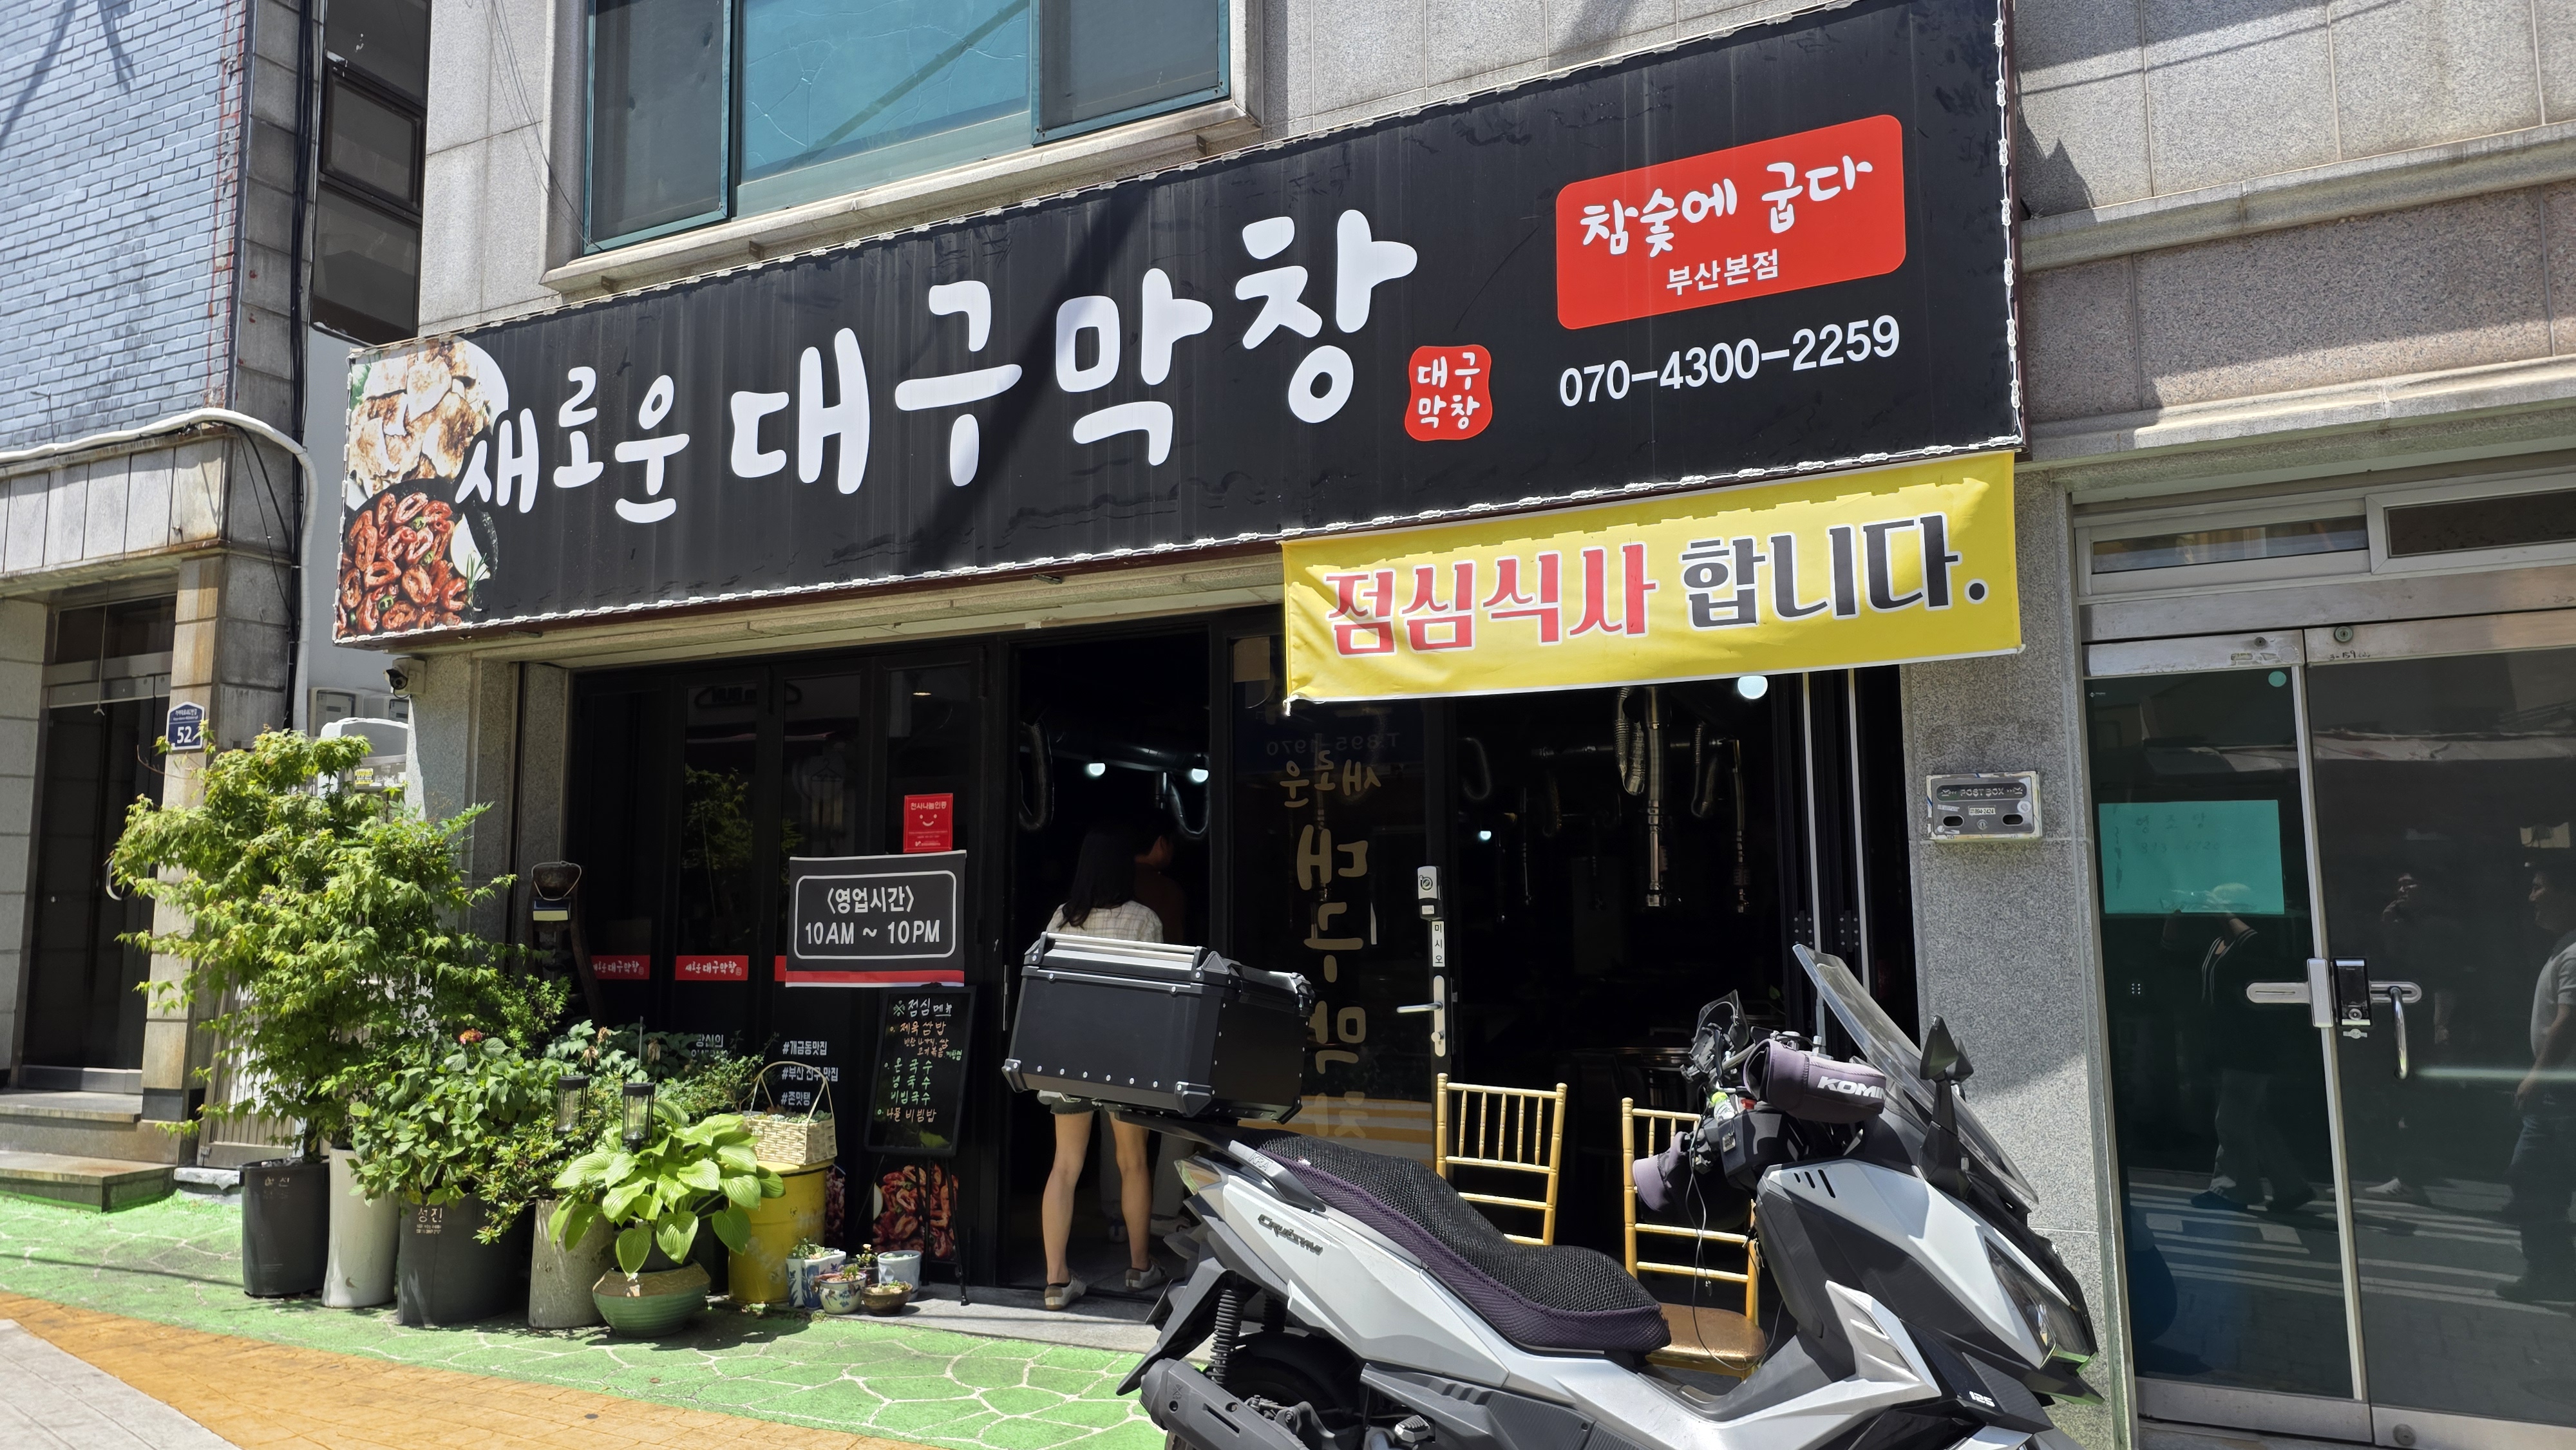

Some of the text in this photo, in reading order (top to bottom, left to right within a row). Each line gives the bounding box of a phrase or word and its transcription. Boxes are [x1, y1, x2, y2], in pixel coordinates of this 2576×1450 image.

[1580, 155, 1874, 258] 참숯에 굽다
[1665, 249, 1780, 296] 부산본점
[455, 209, 1417, 523] 새로운 대구막창
[1417, 351, 1481, 390] 대구
[1559, 314, 1900, 408] 070-4300-2259
[1417, 394, 1481, 430] 막창
[1325, 513, 1988, 657] 점심식사 합니다.
[176, 726, 192, 744] 52
[1960, 787, 2004, 798] POST BOX
[805, 921, 854, 945] 10AM
[887, 919, 940, 944] 10PM
[1434, 923, 1443, 964] 미시오
[907, 997, 952, 1017] 점심 메뉴
[782, 1040, 828, 1056] #개금동맛집
[781, 1066, 804, 1081] #부산
[823, 1066, 838, 1082] 맛집
[781, 1091, 811, 1106] #존맛탱
[1969, 1391, 1996, 1408] 125
